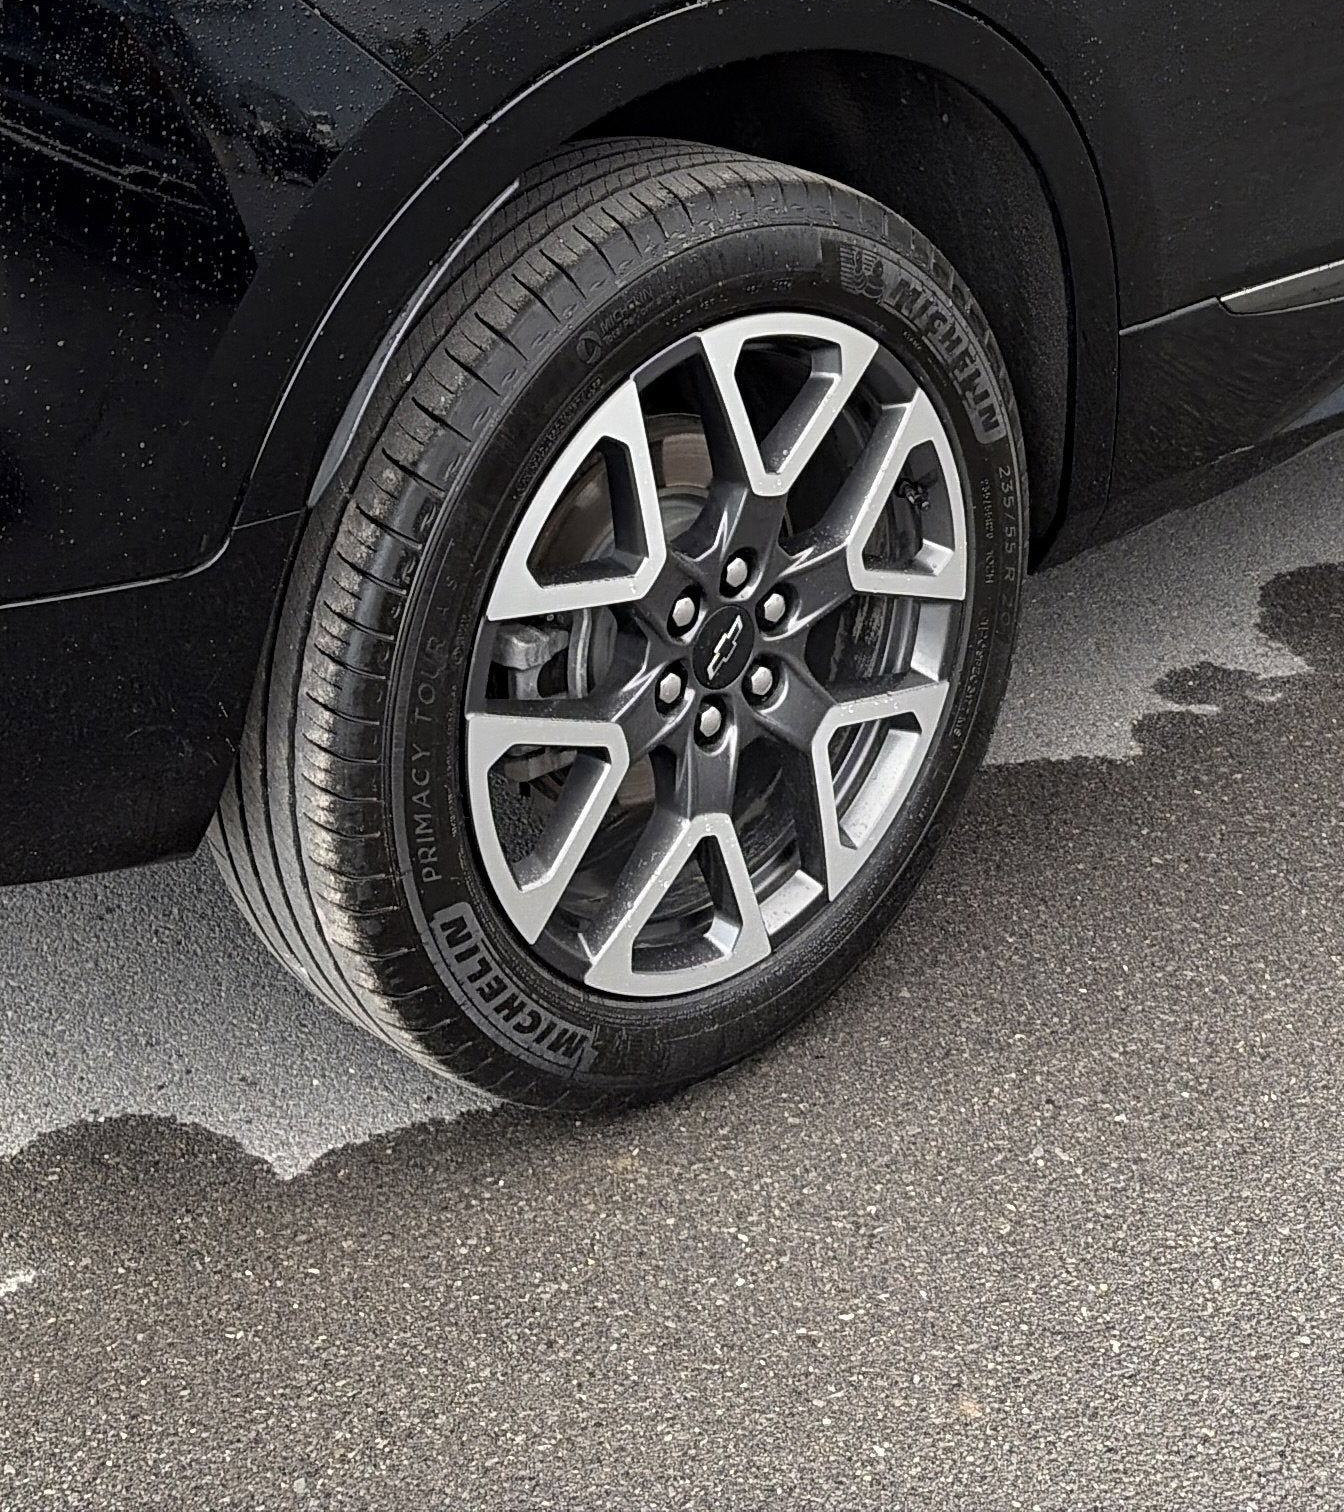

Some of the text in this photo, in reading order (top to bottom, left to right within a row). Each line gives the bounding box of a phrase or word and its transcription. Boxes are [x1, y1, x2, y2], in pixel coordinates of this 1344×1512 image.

[887, 277, 1002, 434] MICHELIN
[997, 465, 1016, 554] 235/55
[413, 637, 449, 724] TOUR
[411, 743, 443, 883] PRIMACY
[439, 915, 588, 1059] MICHELIN
